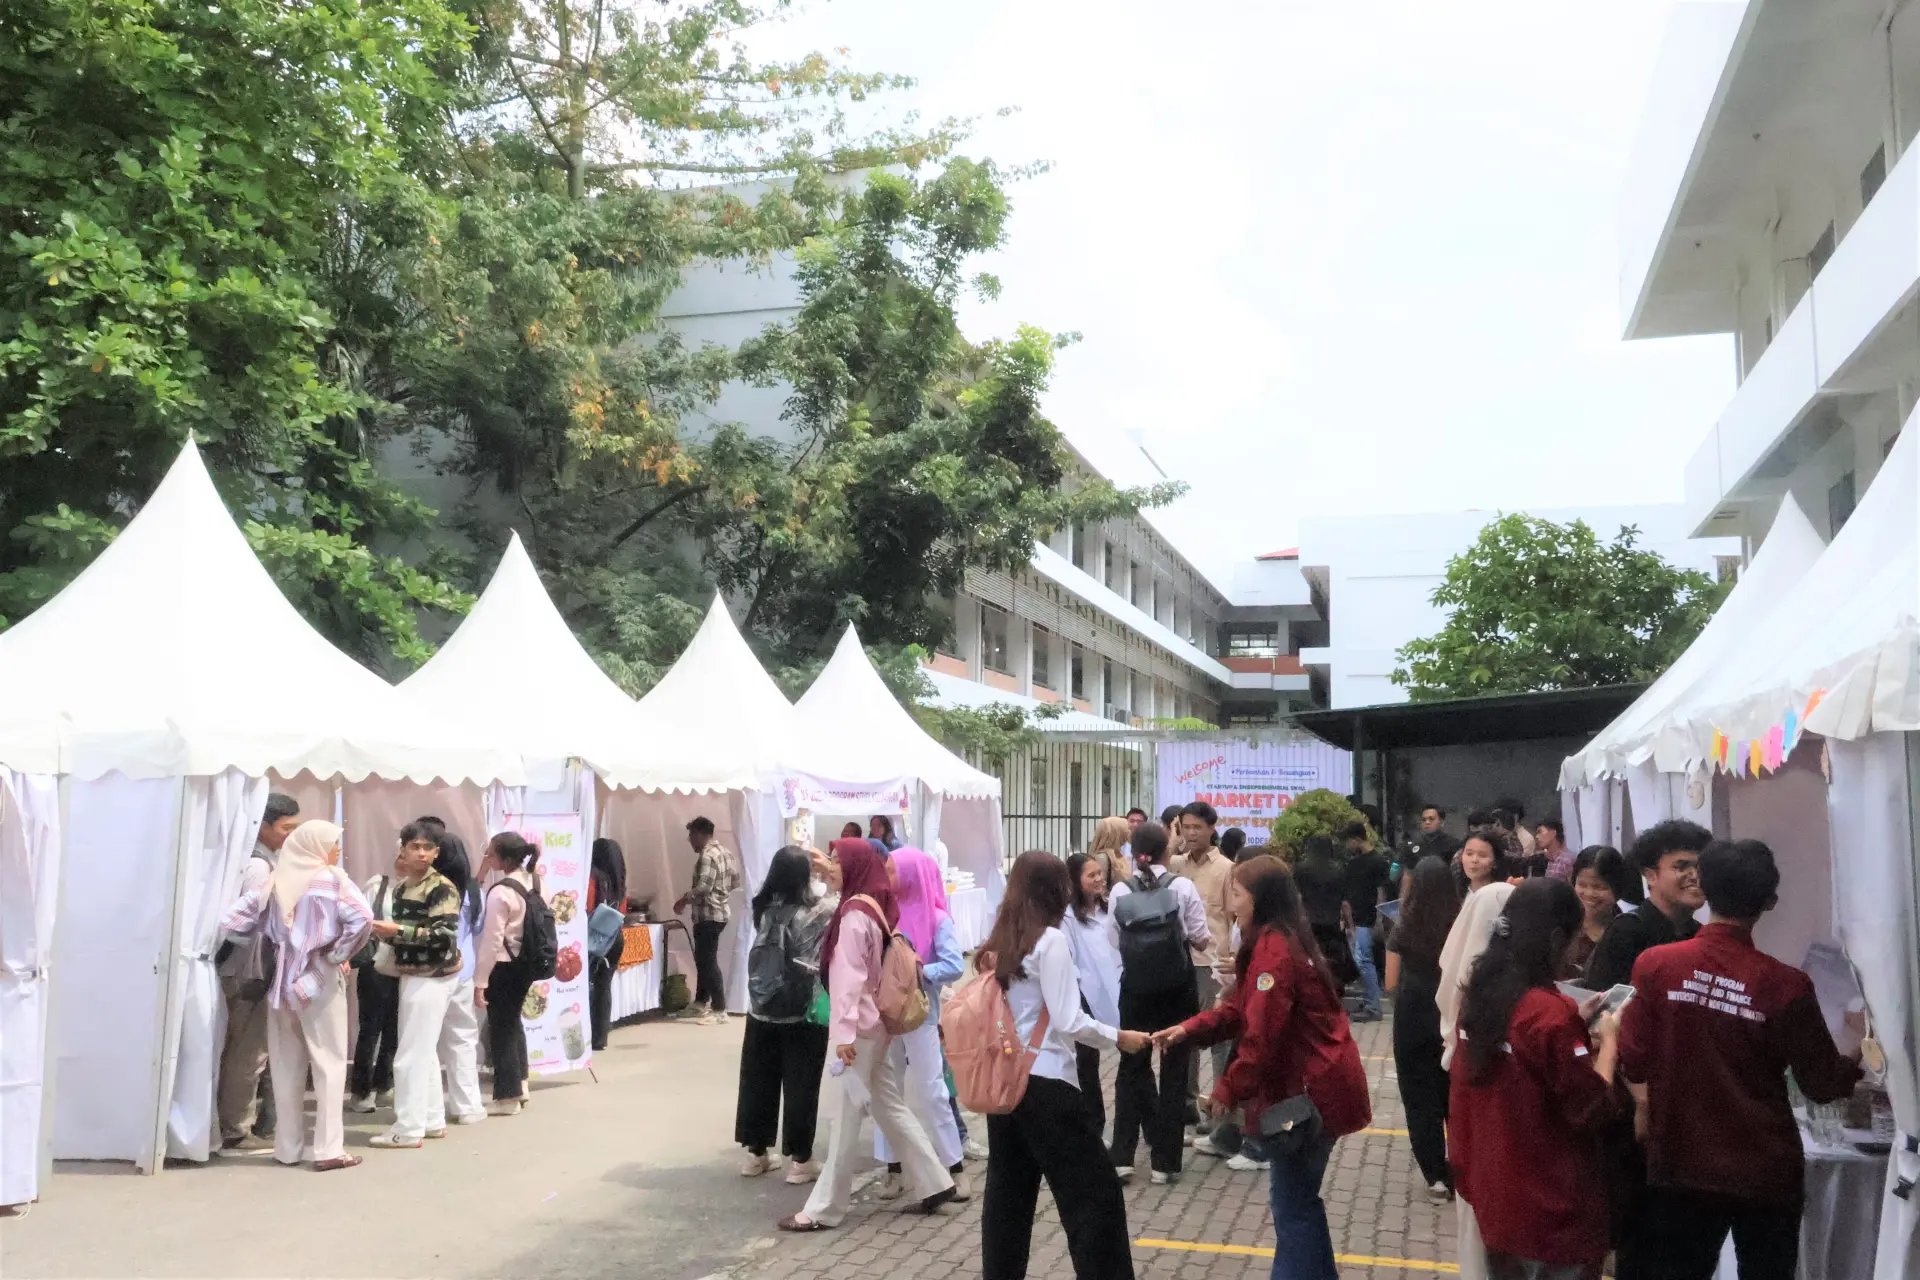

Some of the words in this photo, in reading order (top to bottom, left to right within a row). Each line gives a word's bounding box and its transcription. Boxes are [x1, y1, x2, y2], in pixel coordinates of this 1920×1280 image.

[1195, 792, 1275, 808] MARKET
[1693, 969, 1714, 983] STUDY
[1714, 975, 1747, 992] PROGRAM
[1710, 988, 1725, 998] AND
[1726, 991, 1753, 1006] FINANCE
